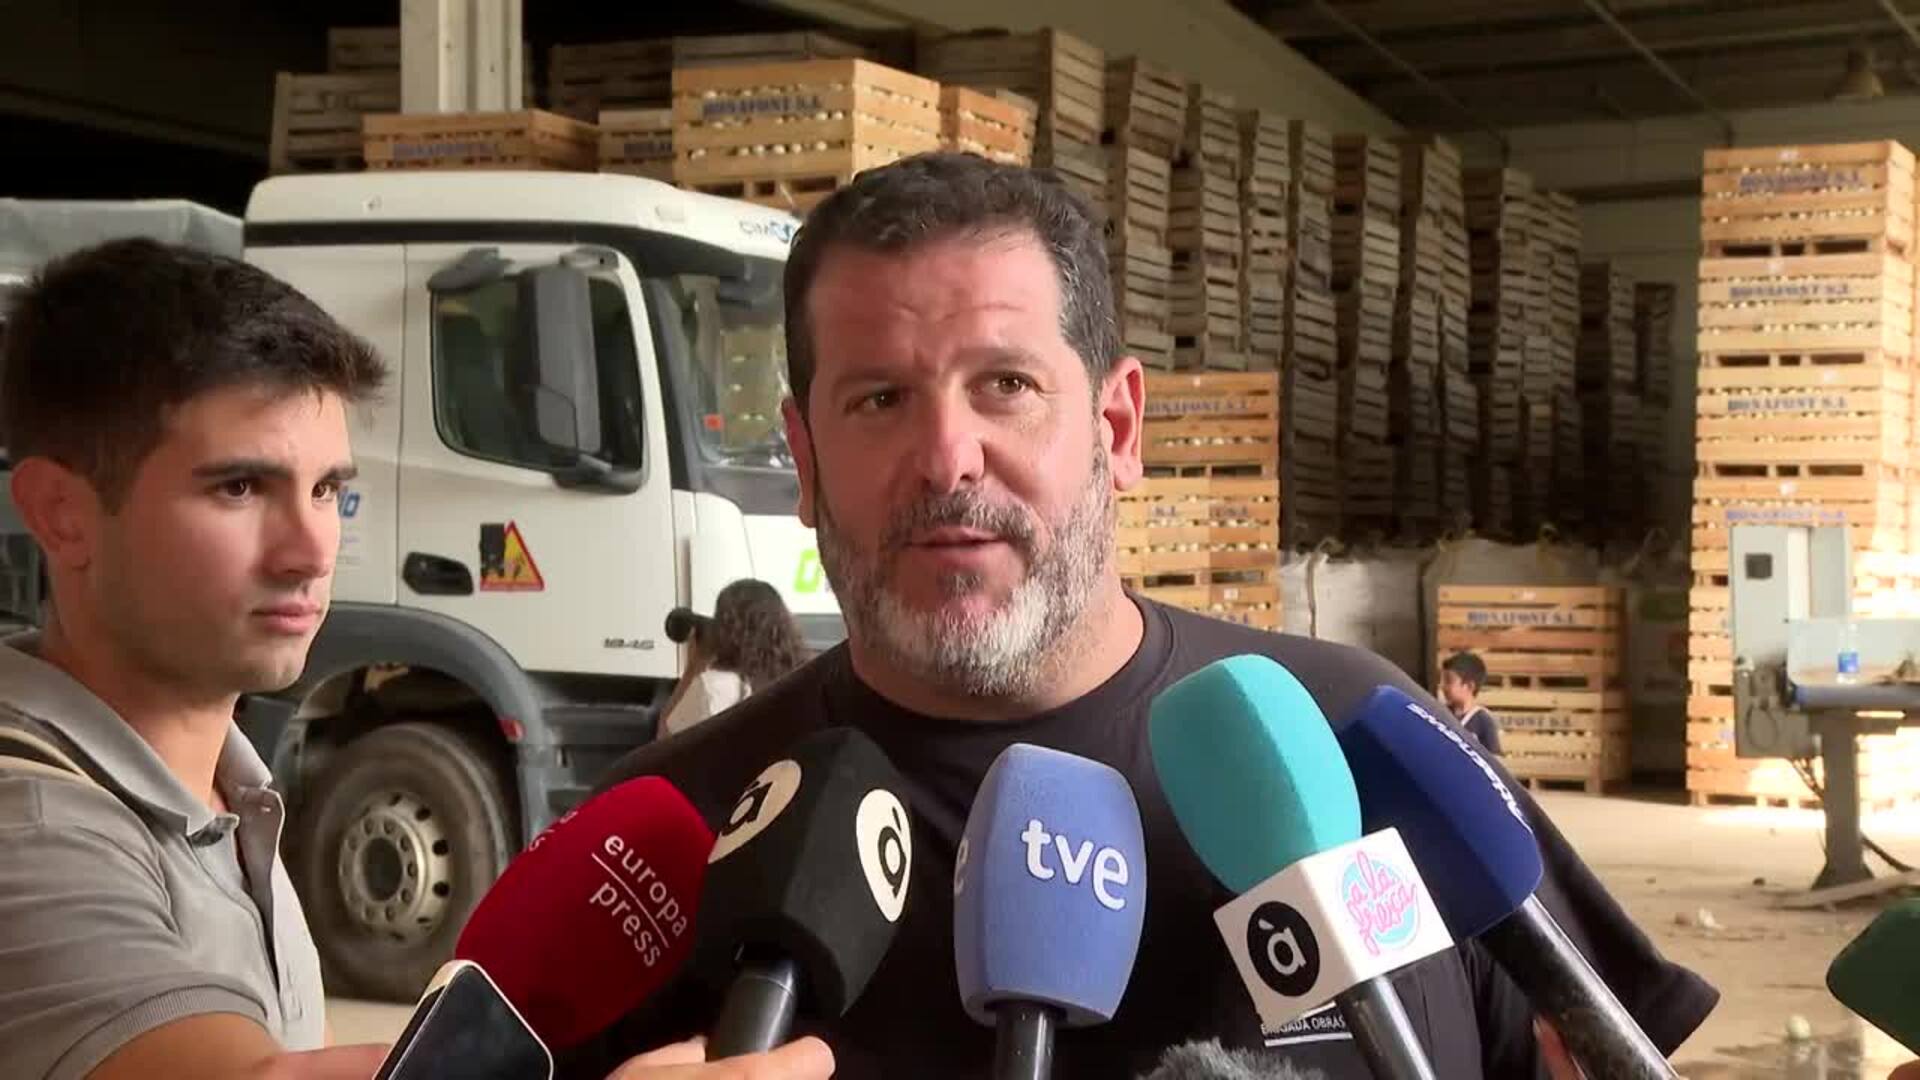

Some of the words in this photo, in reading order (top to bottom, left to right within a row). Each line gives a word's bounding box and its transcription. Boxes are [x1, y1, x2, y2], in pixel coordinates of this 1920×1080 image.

[604, 835, 688, 937] europa
[1021, 819, 1129, 911] tve
[589, 882, 661, 967] press
[1311, 1014, 1347, 1030] OBRAS
